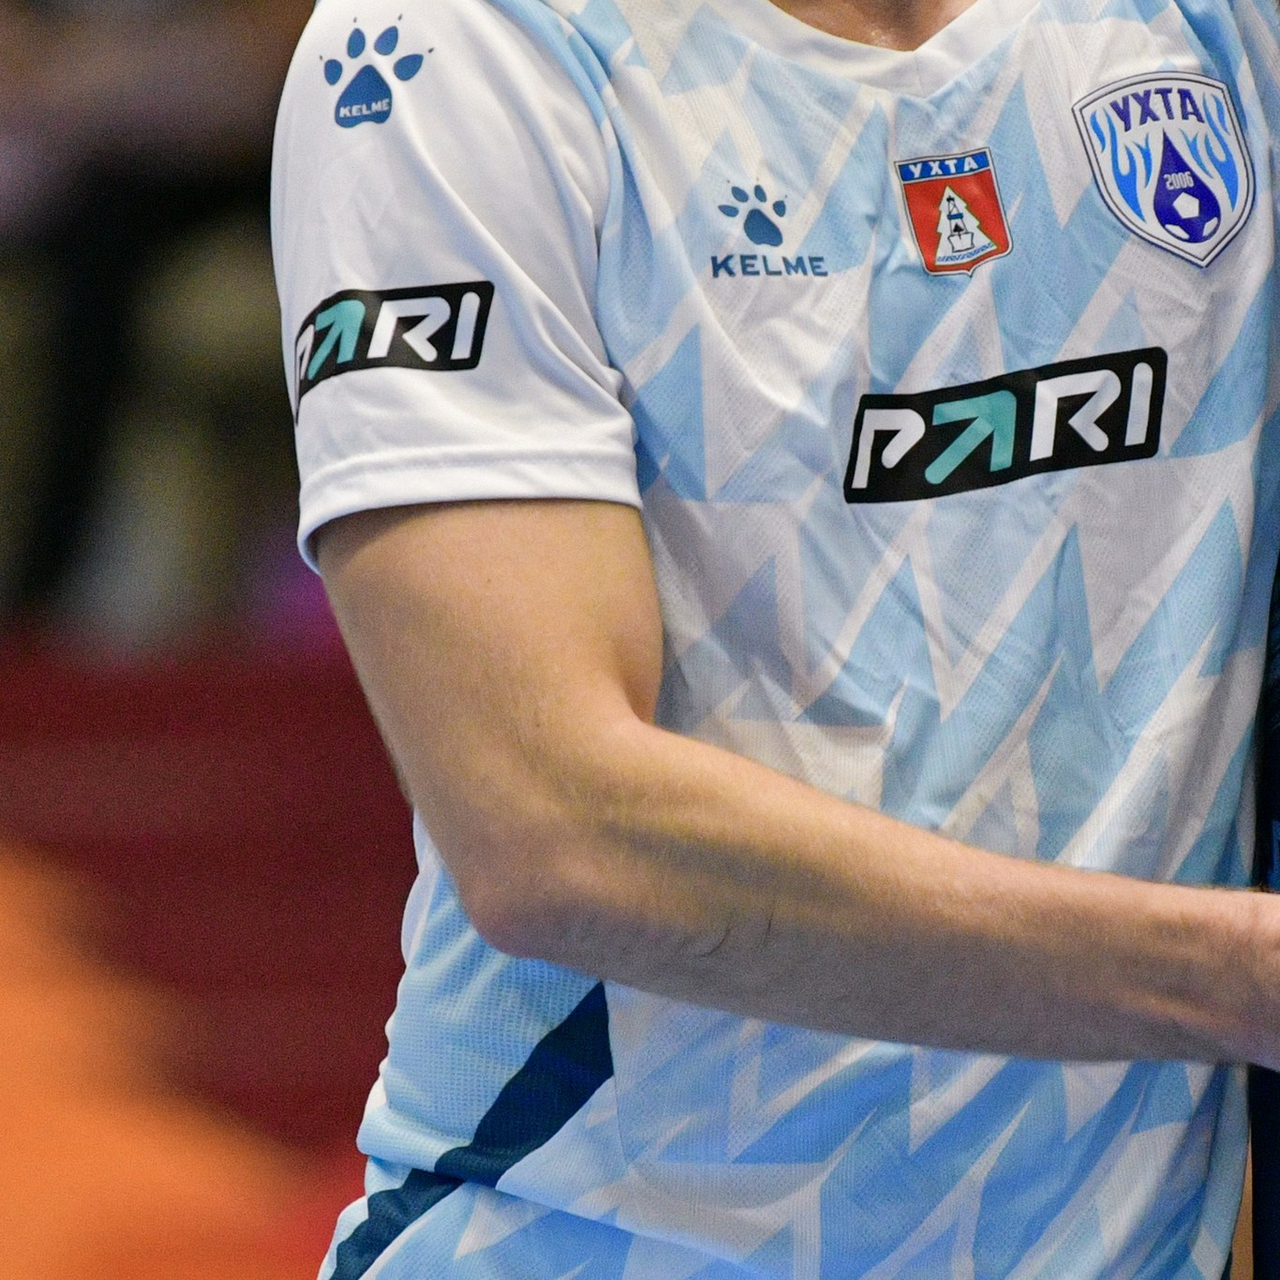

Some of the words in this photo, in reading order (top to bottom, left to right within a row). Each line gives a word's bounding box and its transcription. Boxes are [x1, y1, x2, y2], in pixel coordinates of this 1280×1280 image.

[339, 98, 390, 118] KELME
[1109, 87, 1205, 133] УХТА
[908, 156, 979, 179] УХТА
[1163, 171, 1195, 191] 2006
[710, 254, 829, 278] KELME
[851, 362, 1153, 489] PARI
